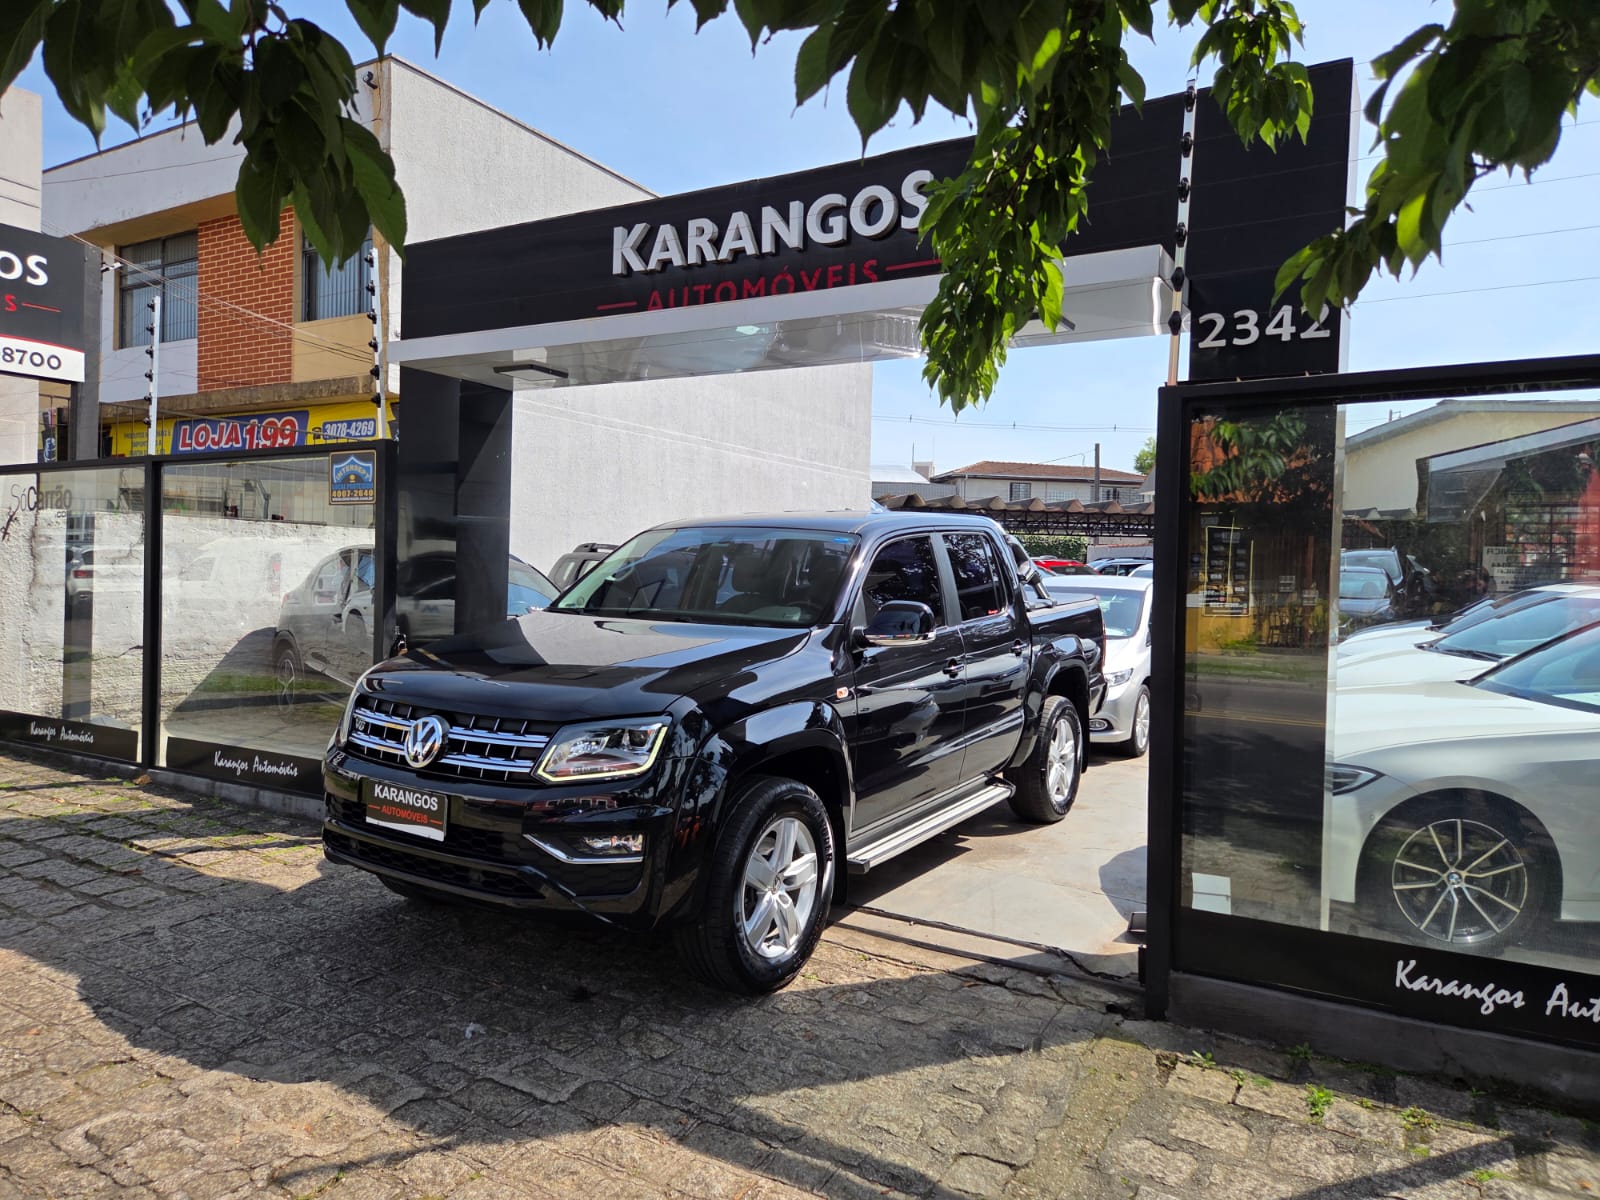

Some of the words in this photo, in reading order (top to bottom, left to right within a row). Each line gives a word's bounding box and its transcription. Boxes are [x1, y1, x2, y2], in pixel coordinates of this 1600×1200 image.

[612, 169, 936, 276] KARANGOS
[647, 265, 878, 311] AUTOMÓVEIS
[1198, 304, 1331, 349] 2342
[179, 422, 242, 451] LOJA
[325, 421, 374, 437] 3078-4269
[214, 750, 249, 776] Karangos
[252, 755, 299, 777] Automóveis
[374, 783, 438, 811] KARANGOS
[381, 804, 428, 824] AUTOMÓVEIS
[1395, 959, 1526, 1015] Karangos
